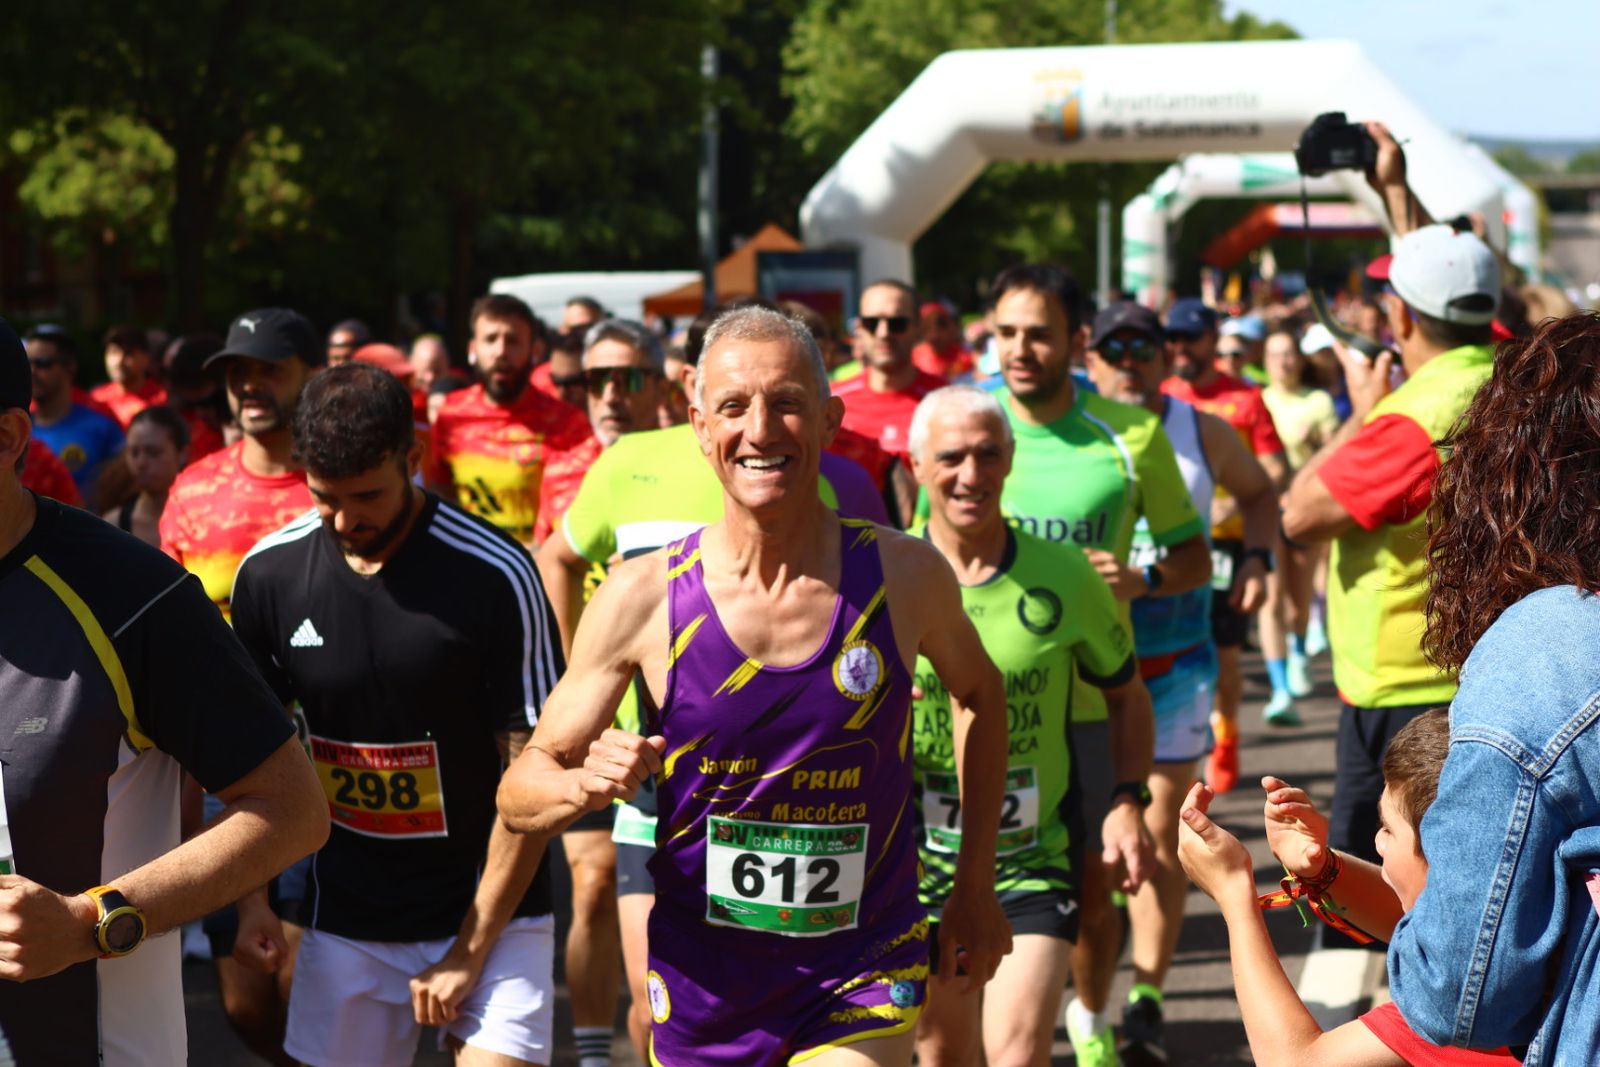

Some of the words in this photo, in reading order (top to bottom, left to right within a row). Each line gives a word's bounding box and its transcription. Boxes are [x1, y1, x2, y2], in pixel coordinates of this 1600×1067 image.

[1099, 121, 1125, 138] de
[1134, 119, 1261, 138] Salamanca
[331, 768, 420, 811] 298
[792, 766, 862, 790] PRIM
[771, 802, 867, 823] Macotera
[939, 794, 1022, 829] 72
[752, 836, 824, 852] CARRERA
[731, 853, 840, 904] 612
